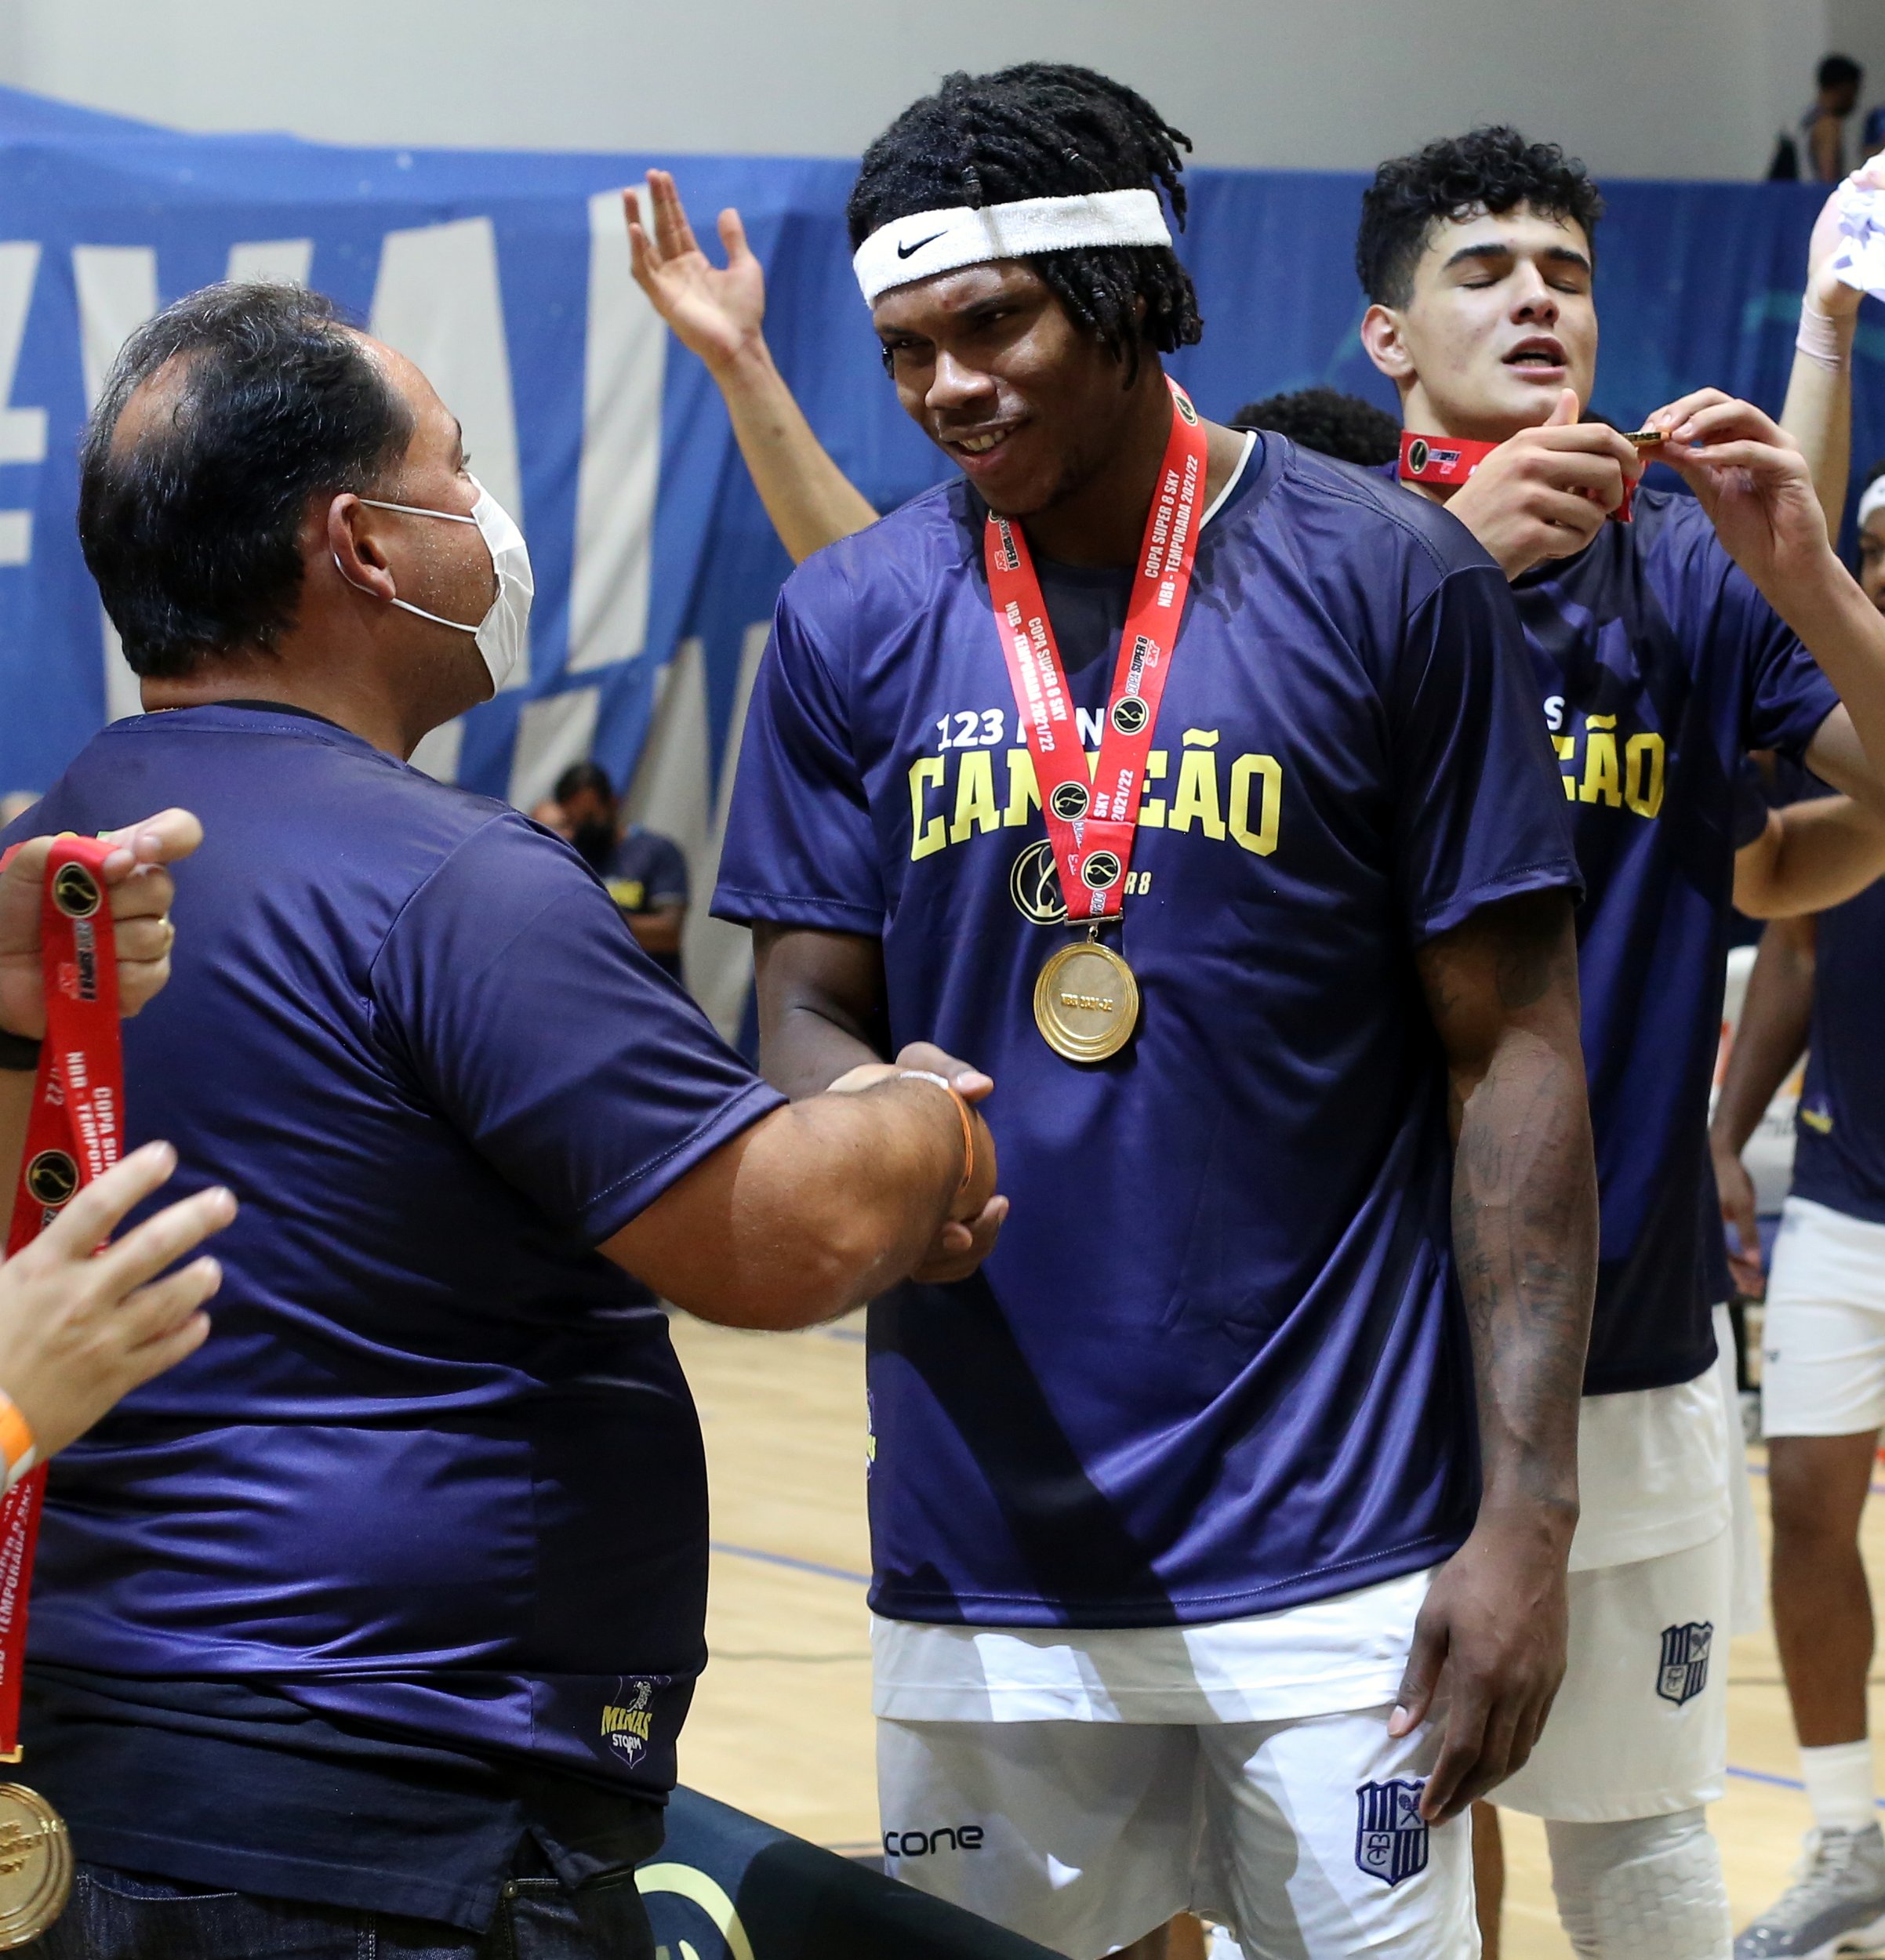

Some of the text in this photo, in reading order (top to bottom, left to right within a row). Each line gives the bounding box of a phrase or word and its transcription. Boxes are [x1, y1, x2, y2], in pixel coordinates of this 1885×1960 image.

[1180, 454, 1198, 503] 2021/22
[1144, 469, 1180, 579] COPA SUPER 8 SKY
[1164, 503, 1191, 573] TEMPORADA
[1005, 601, 1022, 627] NBB
[1157, 581, 1175, 608] NBB
[1013, 632, 1042, 702] TEMPORADA
[1028, 617, 1067, 721] COPA SUPER 8 SKY
[1126, 636, 1148, 695] COPA SUPER 8
[936, 708, 1004, 752] 123
[1030, 702, 1055, 753] 2021/22
[1093, 792, 1110, 818] SKY
[1110, 768, 1134, 821] 2021/22
[64, 1051, 88, 1089] NBB
[92, 1087, 115, 1134] COPA
[601, 1705, 652, 1740] MINAS
[612, 1733, 641, 1750] STORM
[884, 1826, 984, 1857] cone
